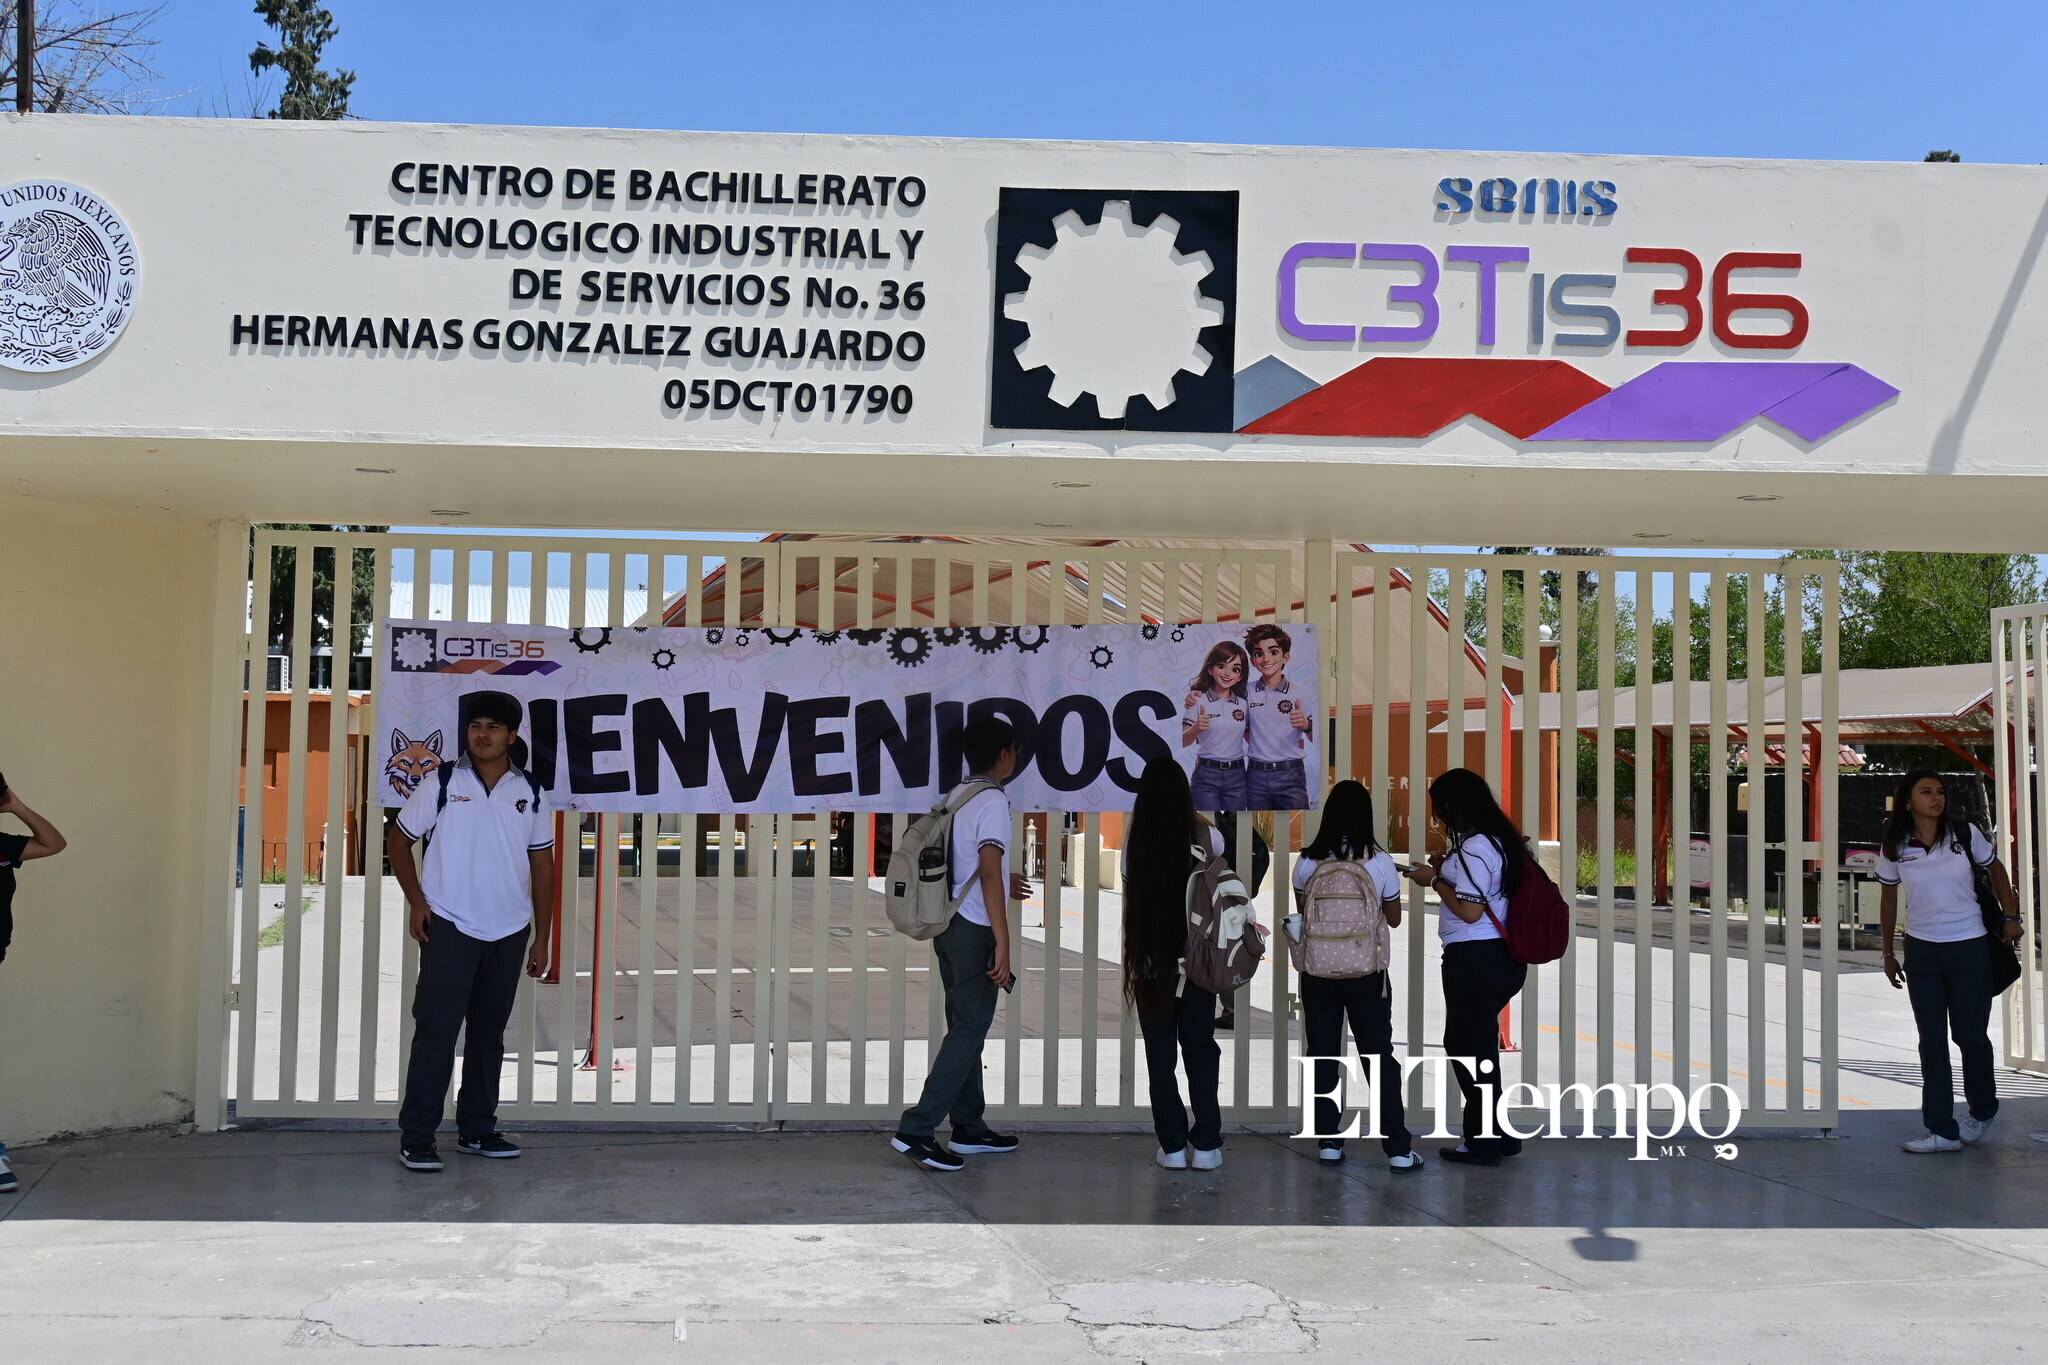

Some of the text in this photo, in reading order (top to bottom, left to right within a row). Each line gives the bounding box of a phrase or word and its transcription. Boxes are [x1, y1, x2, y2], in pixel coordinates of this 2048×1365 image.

[392, 162, 926, 208] CENTRO DE BACHILLERATO
[1, 184, 136, 277] UNIDOS MEXICANOS
[348, 213, 924, 261] TECNOLOGICO INDUSTRIAL Y
[512, 268, 926, 311] DE SERVICIOS No. 36
[232, 314, 926, 362] HERMANAS GONZALEZ GUAJARDO
[663, 379, 913, 415] 05DCT01790
